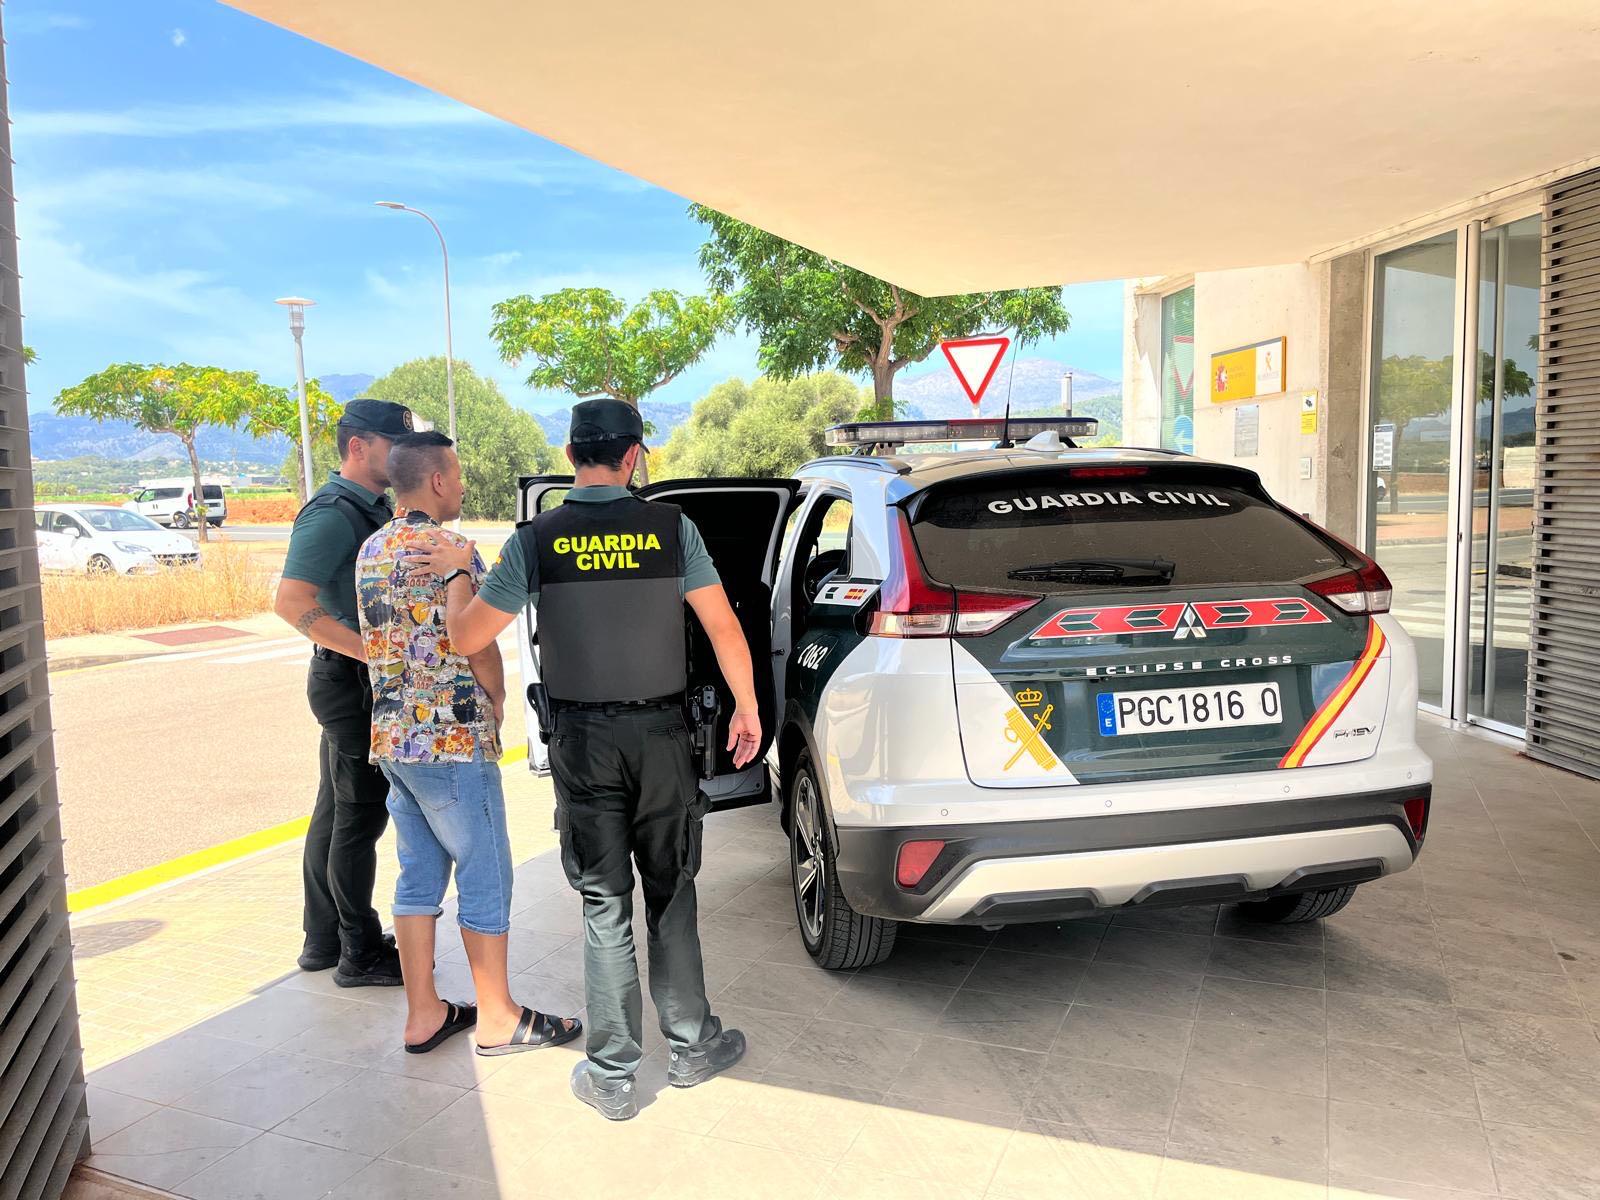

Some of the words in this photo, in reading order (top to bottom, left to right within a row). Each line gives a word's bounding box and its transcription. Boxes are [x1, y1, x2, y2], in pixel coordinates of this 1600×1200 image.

[987, 490, 1143, 514] GUARDIA
[1147, 491, 1231, 507] CIVIL
[553, 533, 661, 554] GUARDIA
[576, 552, 640, 571] CIVIL
[802, 644, 829, 670] 062
[1086, 661, 1203, 676] ECLIPSE
[1220, 655, 1292, 668] CROSS
[1117, 690, 1245, 729] PGC1816
[1104, 718, 1113, 728] E
